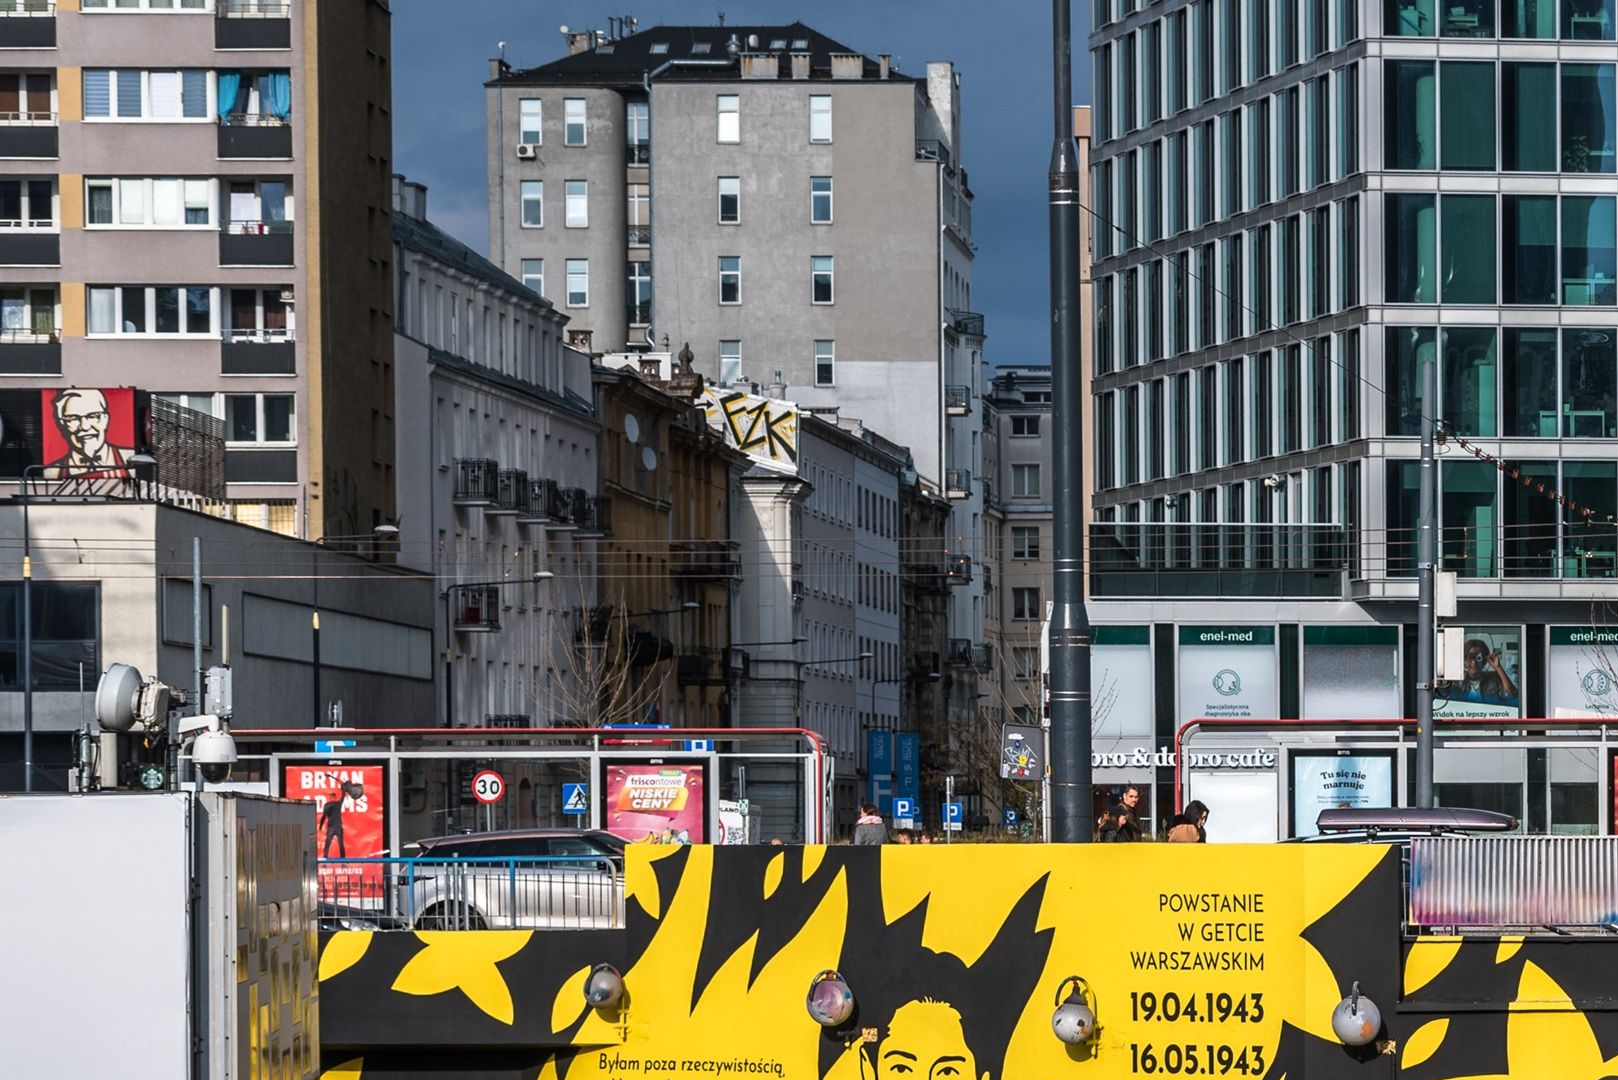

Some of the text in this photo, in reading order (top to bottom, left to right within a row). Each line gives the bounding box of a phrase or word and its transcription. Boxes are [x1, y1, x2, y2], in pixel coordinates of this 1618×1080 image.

[1200, 631, 1253, 641] enel-med
[1132, 747, 1151, 768] &
[631, 777, 682, 786] friscontowe
[1320, 771, 1334, 780] Tu
[477, 779, 500, 795] 30
[1323, 781, 1364, 790] marnuje
[629, 789, 677, 799] NISKIE
[632, 799, 673, 809] CENY
[898, 801, 909, 816] P
[1160, 894, 1263, 912] POWSTANIE
[1178, 923, 1264, 941] W GETCIE
[1130, 951, 1263, 970] WARSZAWSKIM
[1131, 992, 1264, 1023] 19.04.1943
[599, 1053, 785, 1078] Byłam poza rzeczywistością,
[1131, 1043, 1265, 1076] 16.05.1943
